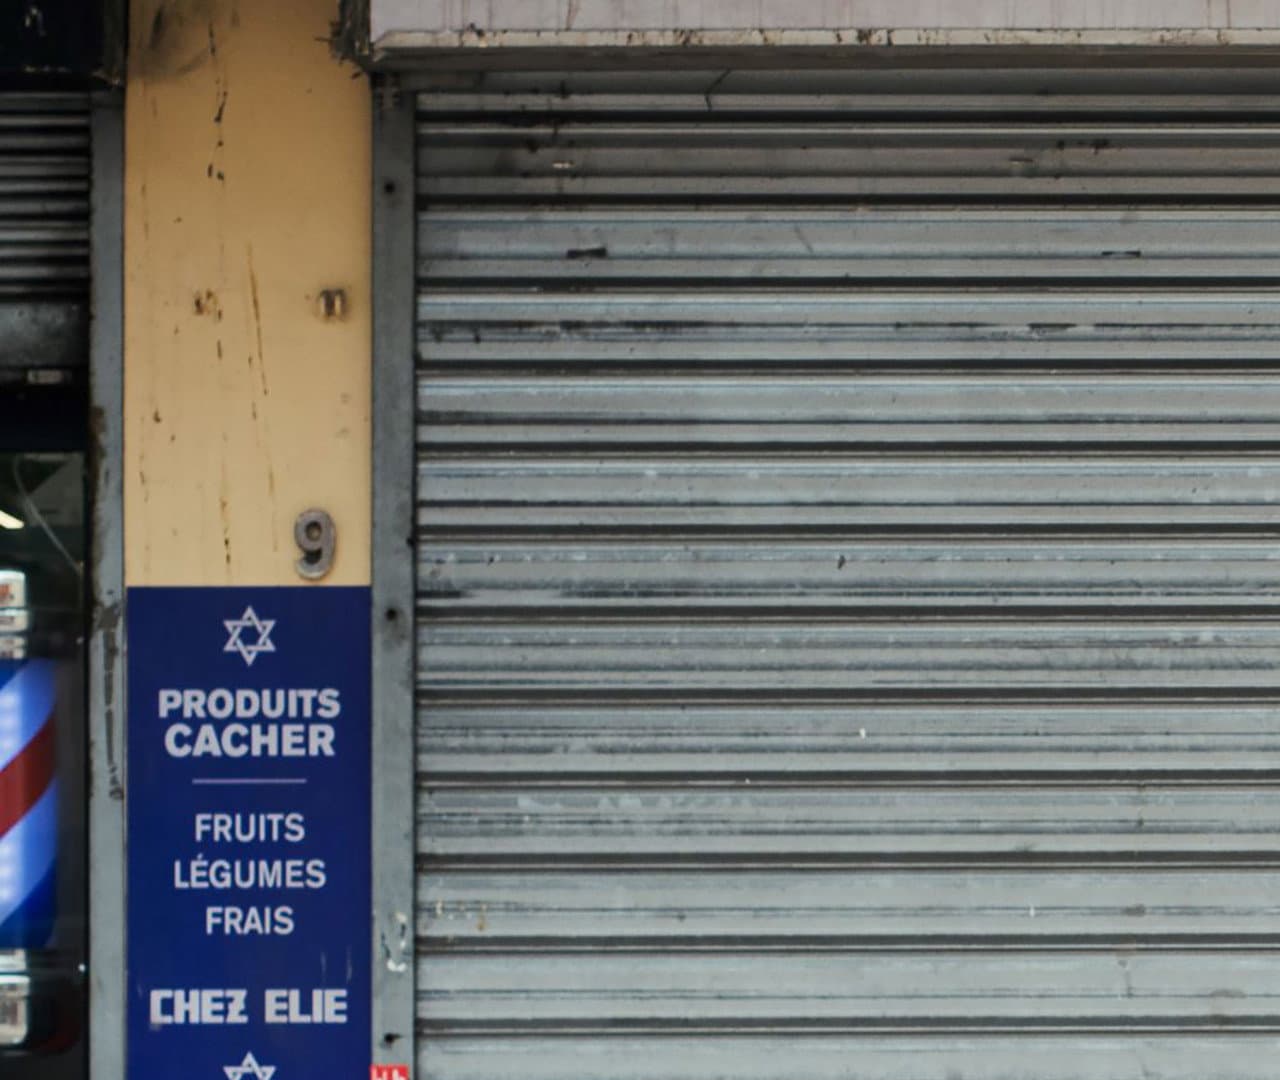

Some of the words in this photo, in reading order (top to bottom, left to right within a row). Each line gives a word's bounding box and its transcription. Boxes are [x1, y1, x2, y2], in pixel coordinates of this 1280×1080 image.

[294, 509, 337, 581] 9
[158, 688, 341, 718] PRODUITS
[164, 723, 336, 757] CACHER
[195, 813, 306, 842] FRUITS
[174, 852, 327, 889] LÉGUMES
[206, 906, 295, 935] FRAIS
[149, 988, 249, 1024] CHEZ
[264, 988, 348, 1024] ELIE
